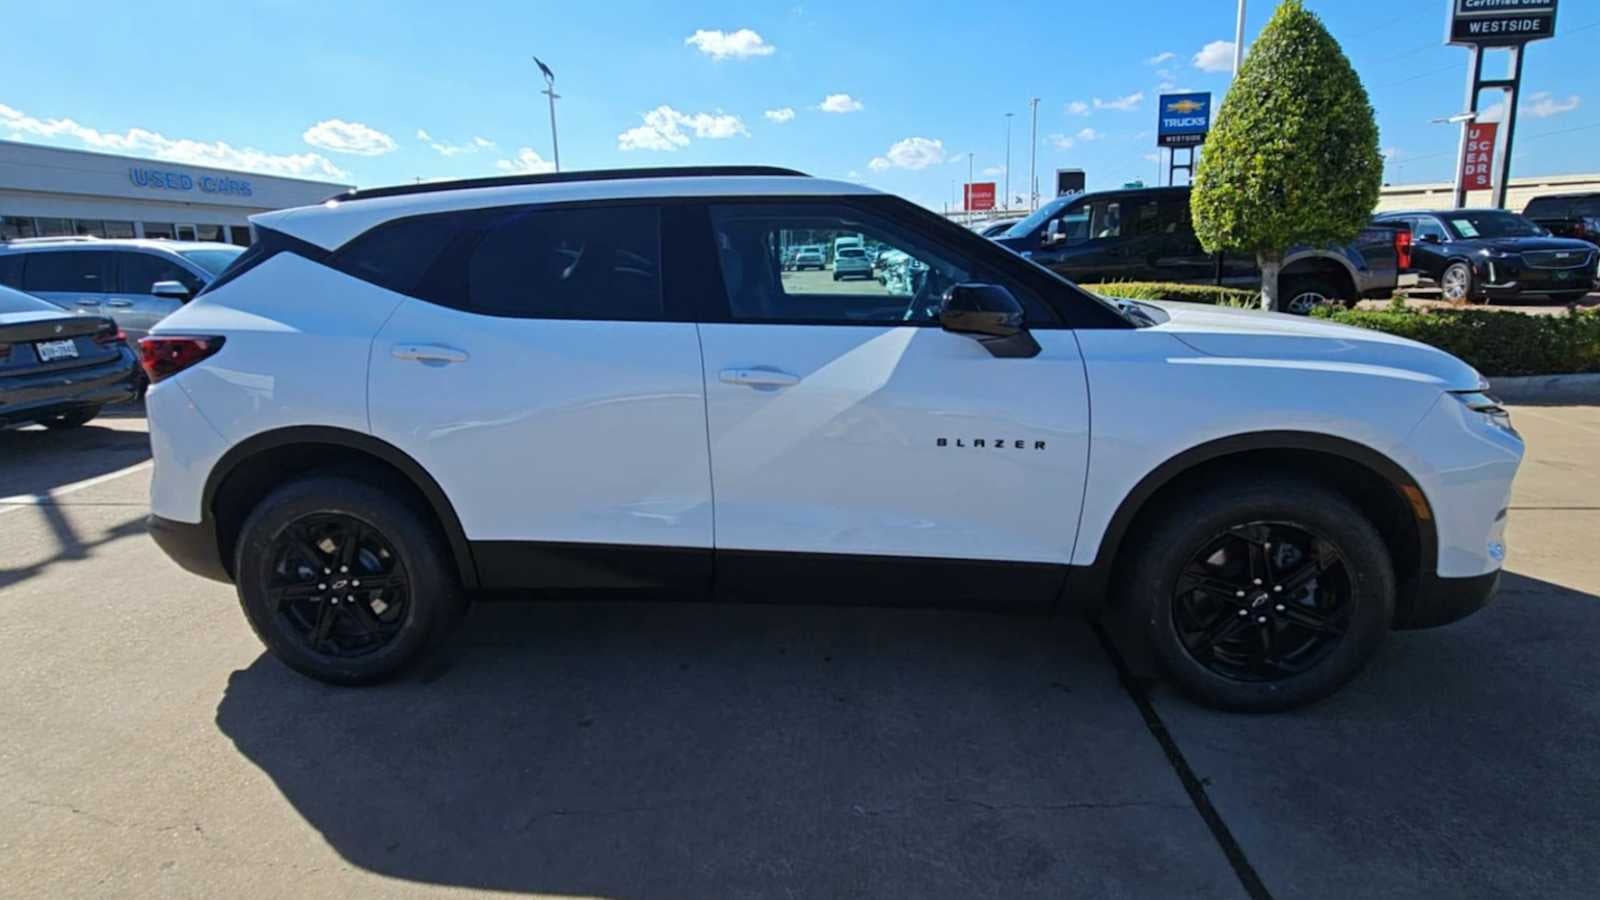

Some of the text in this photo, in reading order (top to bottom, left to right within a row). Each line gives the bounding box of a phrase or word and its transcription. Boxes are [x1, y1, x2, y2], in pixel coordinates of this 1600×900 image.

[1469, 19, 1541, 33] WESTSIDE
[1163, 117, 1206, 128] TRUCKS
[1465, 129, 1480, 175] USED
[1476, 141, 1490, 184] CARS
[130, 167, 253, 197] USED CARS
[936, 438, 1046, 450] BLAZER
